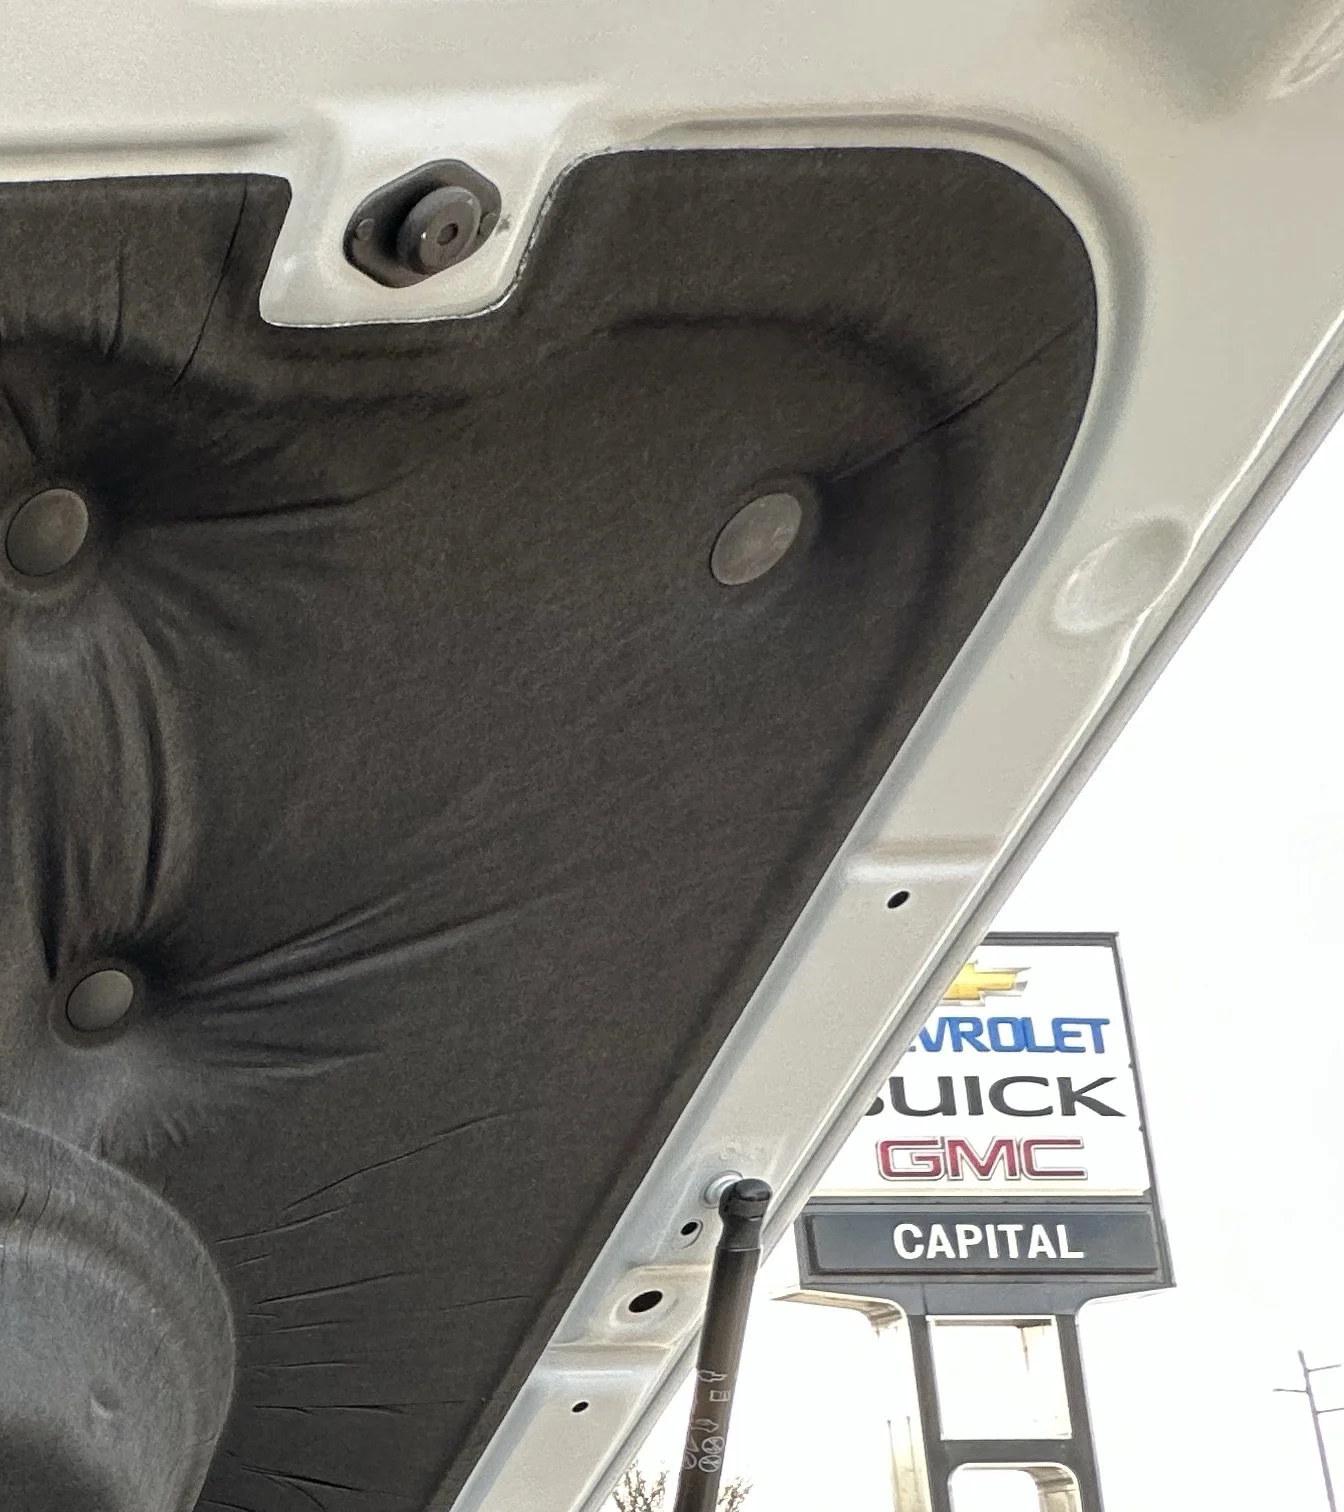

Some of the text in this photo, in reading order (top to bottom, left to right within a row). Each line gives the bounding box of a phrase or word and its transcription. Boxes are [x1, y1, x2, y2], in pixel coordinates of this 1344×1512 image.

[905, 1017, 1110, 1053] VROLET
[864, 1076, 1126, 1117] UICK
[876, 1136, 1088, 1181] GMC
[893, 1223, 1085, 1260] CAPITAL
